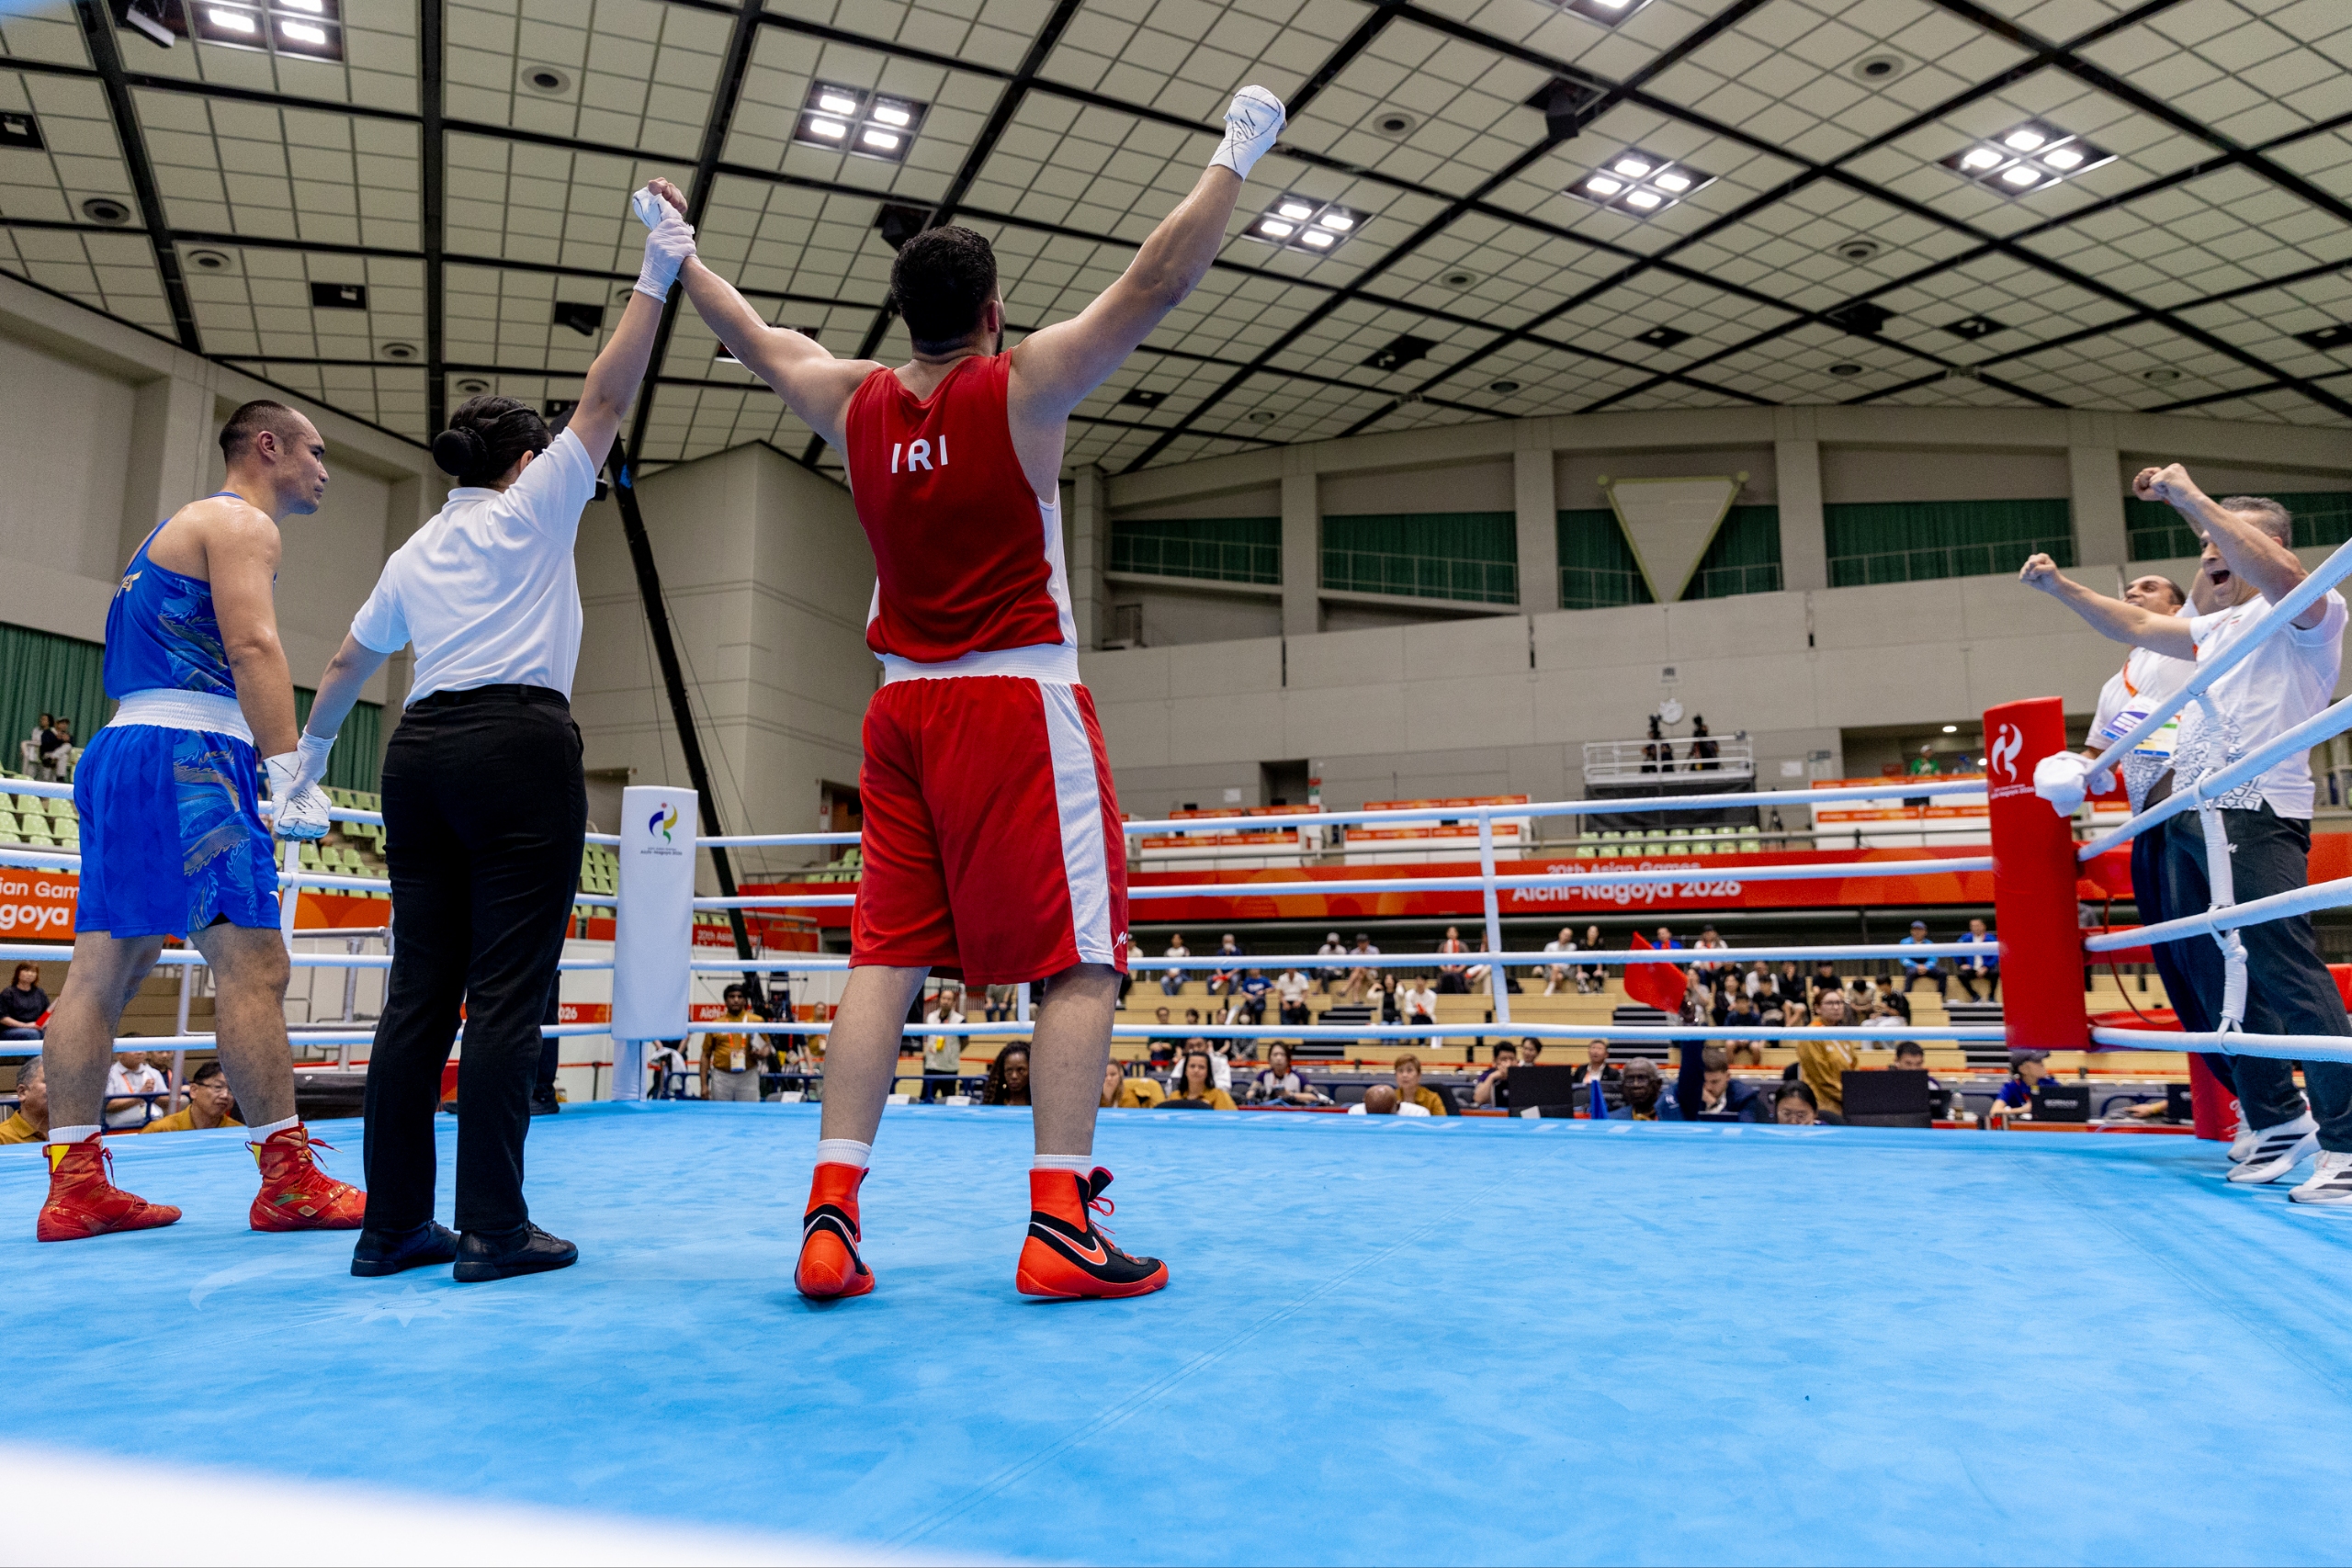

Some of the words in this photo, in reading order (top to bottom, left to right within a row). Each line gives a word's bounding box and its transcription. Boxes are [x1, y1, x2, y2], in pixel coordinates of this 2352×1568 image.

[891, 434, 948, 474] IRI
[1511, 881, 1674, 905] Aichi-Nagoya
[1679, 880, 1742, 898] 2026
